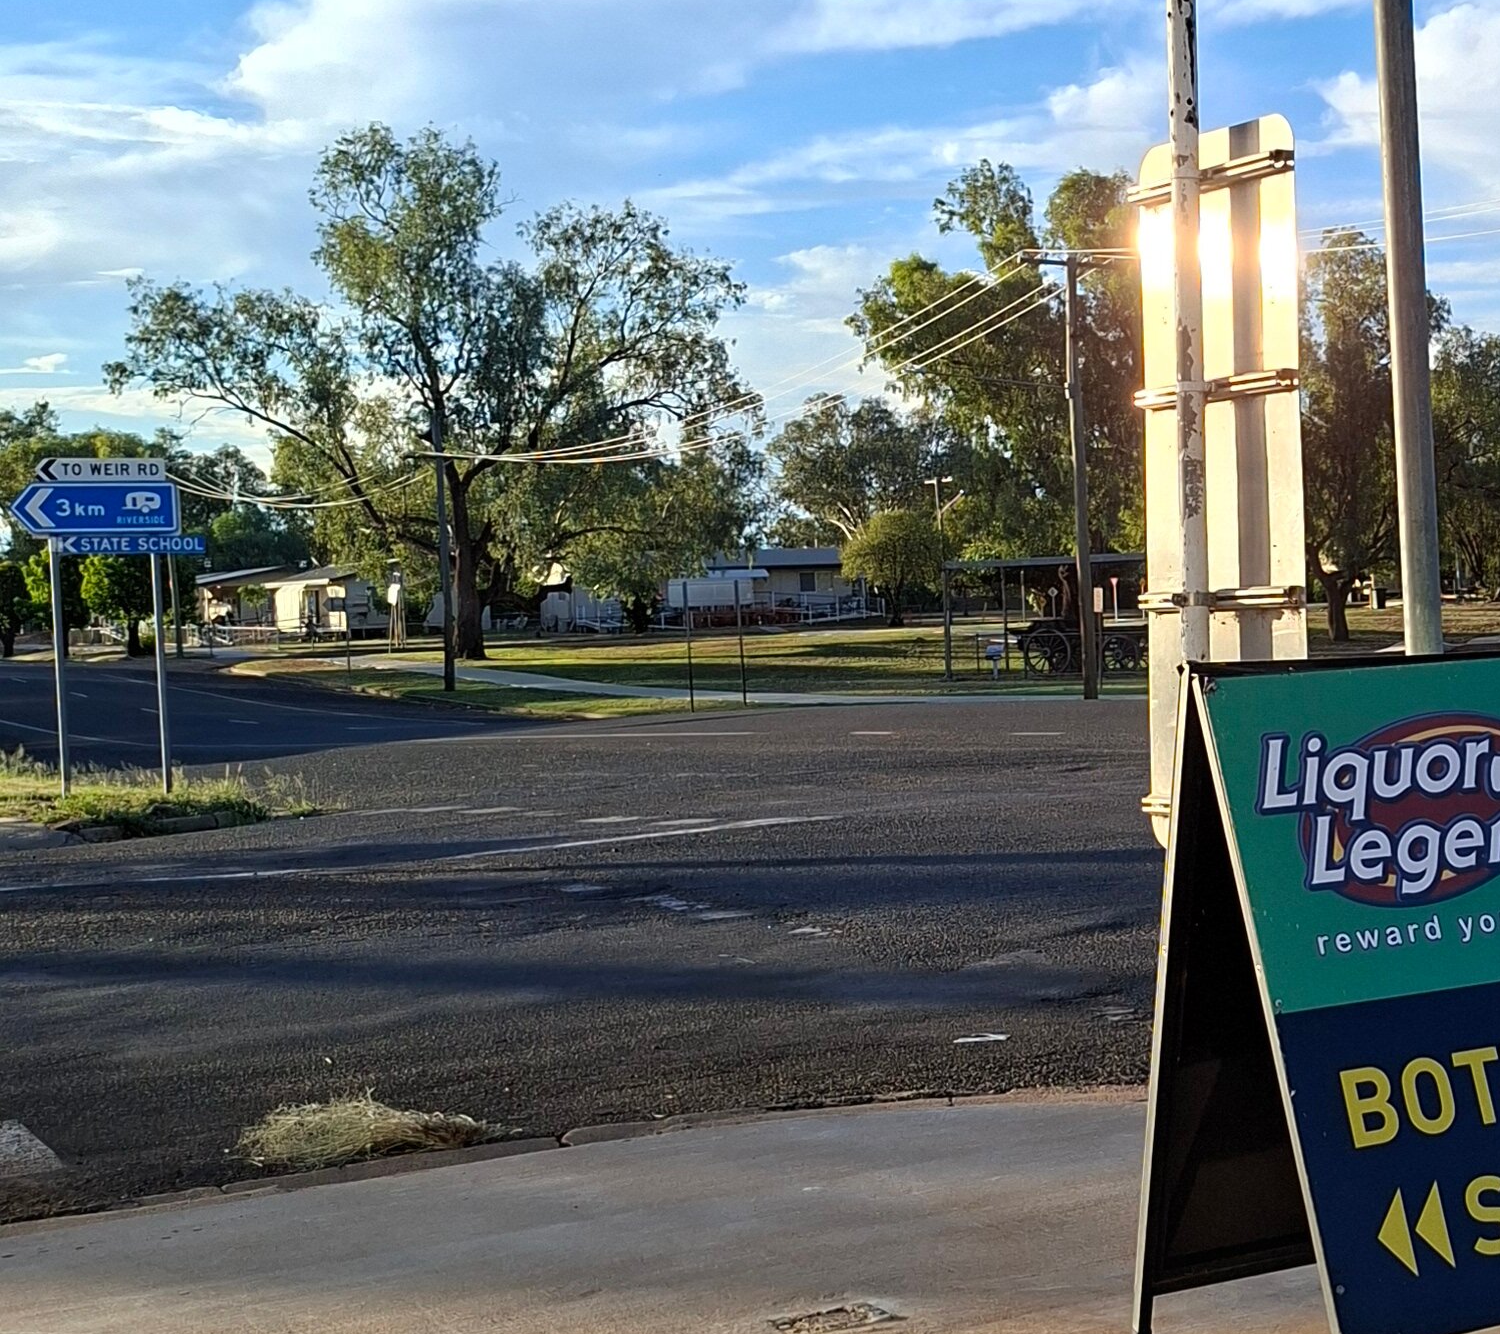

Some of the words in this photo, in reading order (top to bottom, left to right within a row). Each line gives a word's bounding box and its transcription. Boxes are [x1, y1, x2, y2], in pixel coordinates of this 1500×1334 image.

[61, 463, 82, 476] TO
[89, 463, 130, 476] WEIR
[138, 463, 159, 476] RD
[56, 499, 71, 516] 3
[75, 502, 105, 516] km
[116, 515, 166, 524] RIVERSIDE
[80, 537, 131, 551] STATE
[138, 536, 205, 551] SCHOOL
[1260, 734, 1491, 822] Liquor
[1316, 916, 1443, 956] reward
